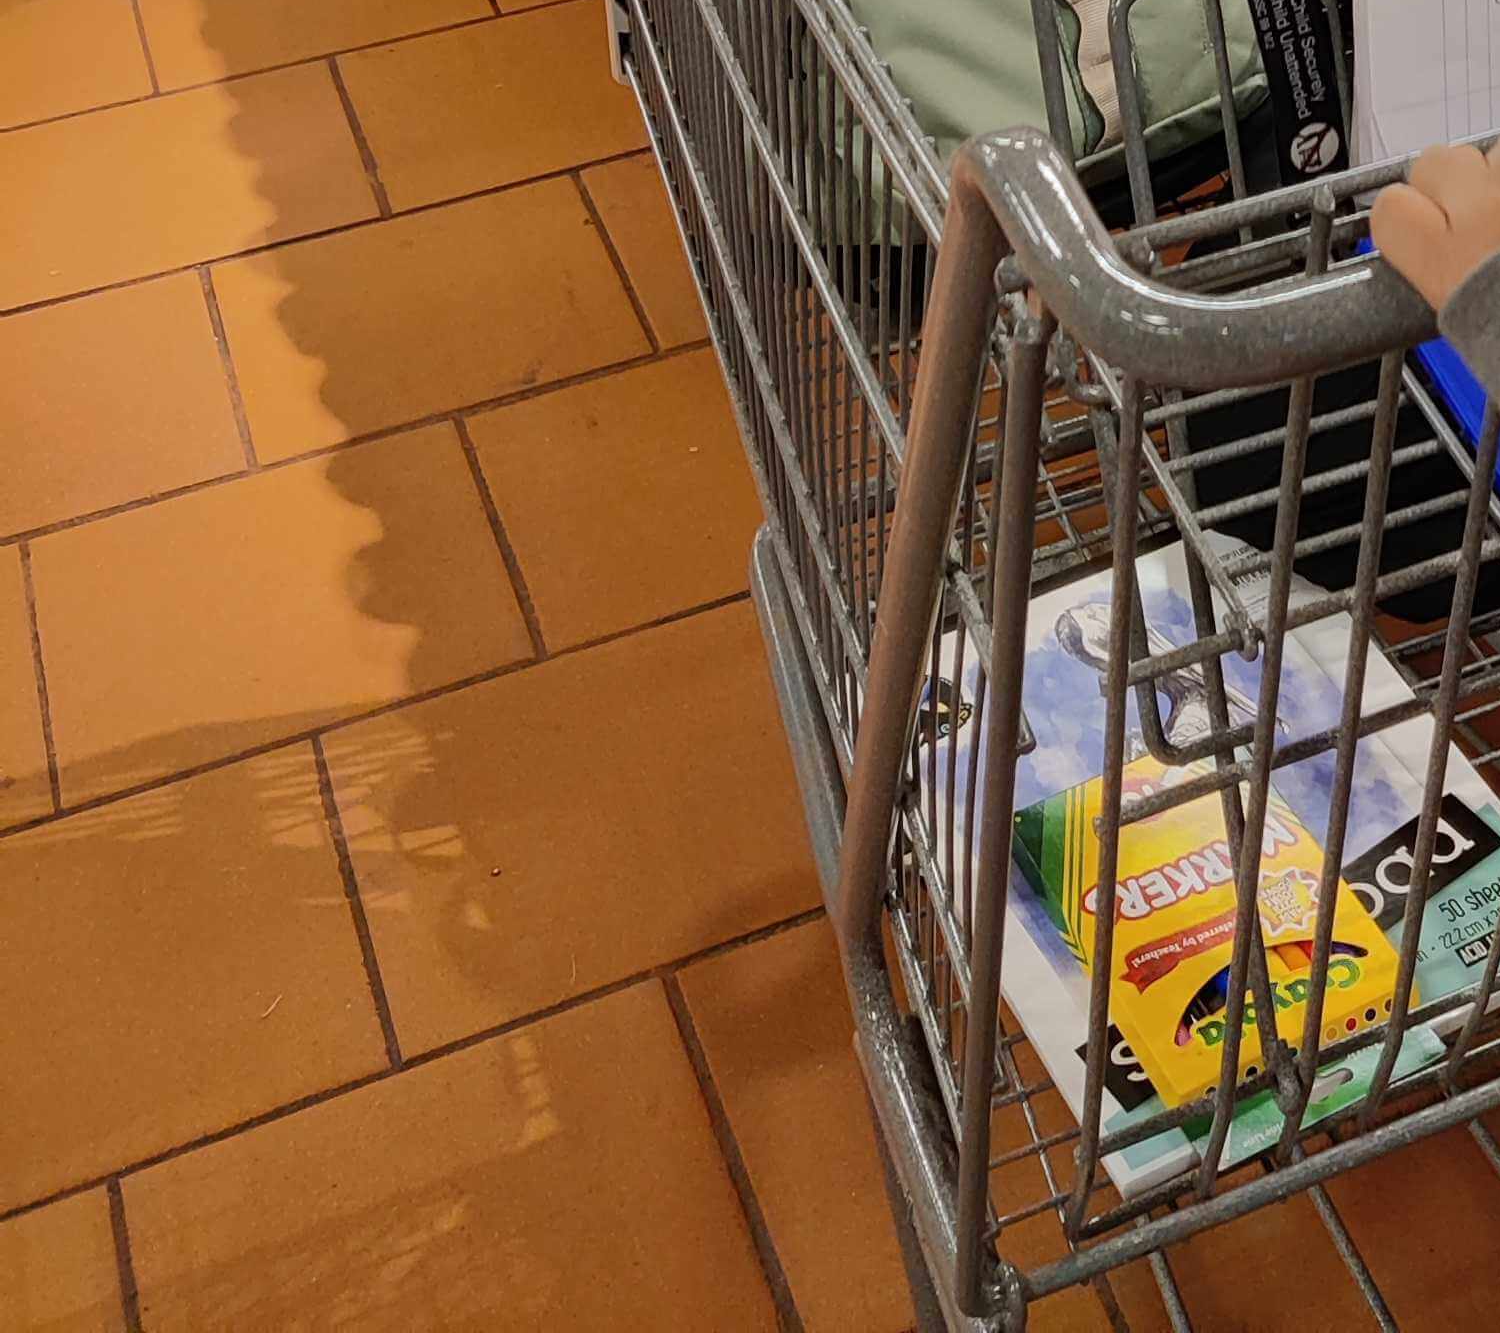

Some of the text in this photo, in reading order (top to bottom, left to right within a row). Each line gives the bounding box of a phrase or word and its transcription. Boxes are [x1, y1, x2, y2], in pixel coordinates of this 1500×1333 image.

[1279, 29, 1313, 119] Unattended
[1301, 35, 1326, 102] Securely
[1437, 898, 1465, 923] 50
[1182, 936, 1196, 948] by
[1462, 920, 1483, 939] cm
[1130, 942, 1182, 969] Teachers!
[1458, 940, 1486, 965] ACID
